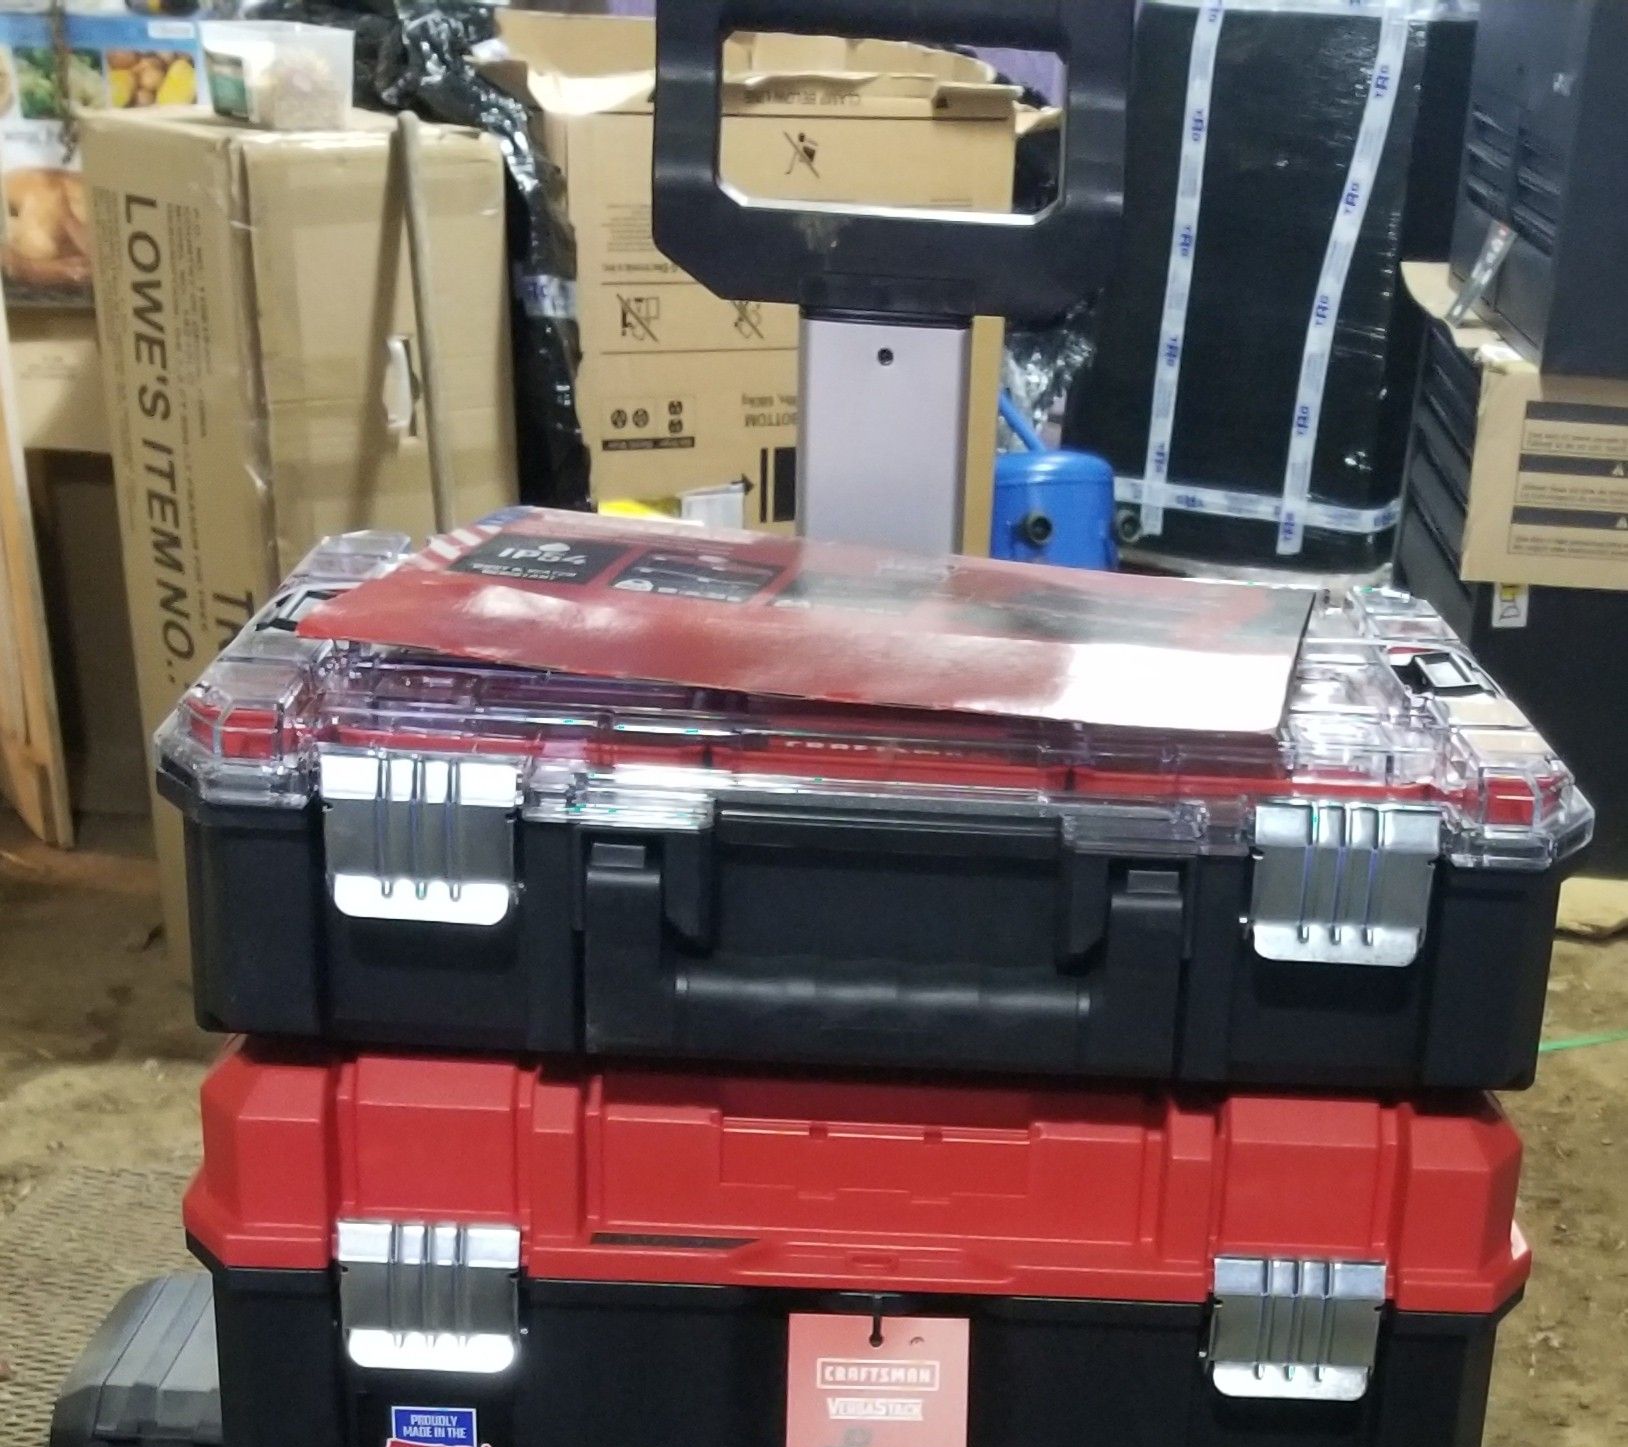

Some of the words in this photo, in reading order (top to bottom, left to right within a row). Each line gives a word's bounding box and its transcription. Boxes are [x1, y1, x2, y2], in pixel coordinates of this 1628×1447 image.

[125, 194, 171, 421] LOWE'S
[142, 437, 185, 575] ITEM
[824, 1365, 932, 1384] CRAFTSMAN
[410, 1414, 458, 1427] PROUDLY
[403, 1426, 432, 1437] MADE
[434, 1427, 445, 1438] IN
[446, 1427, 467, 1439] THE
